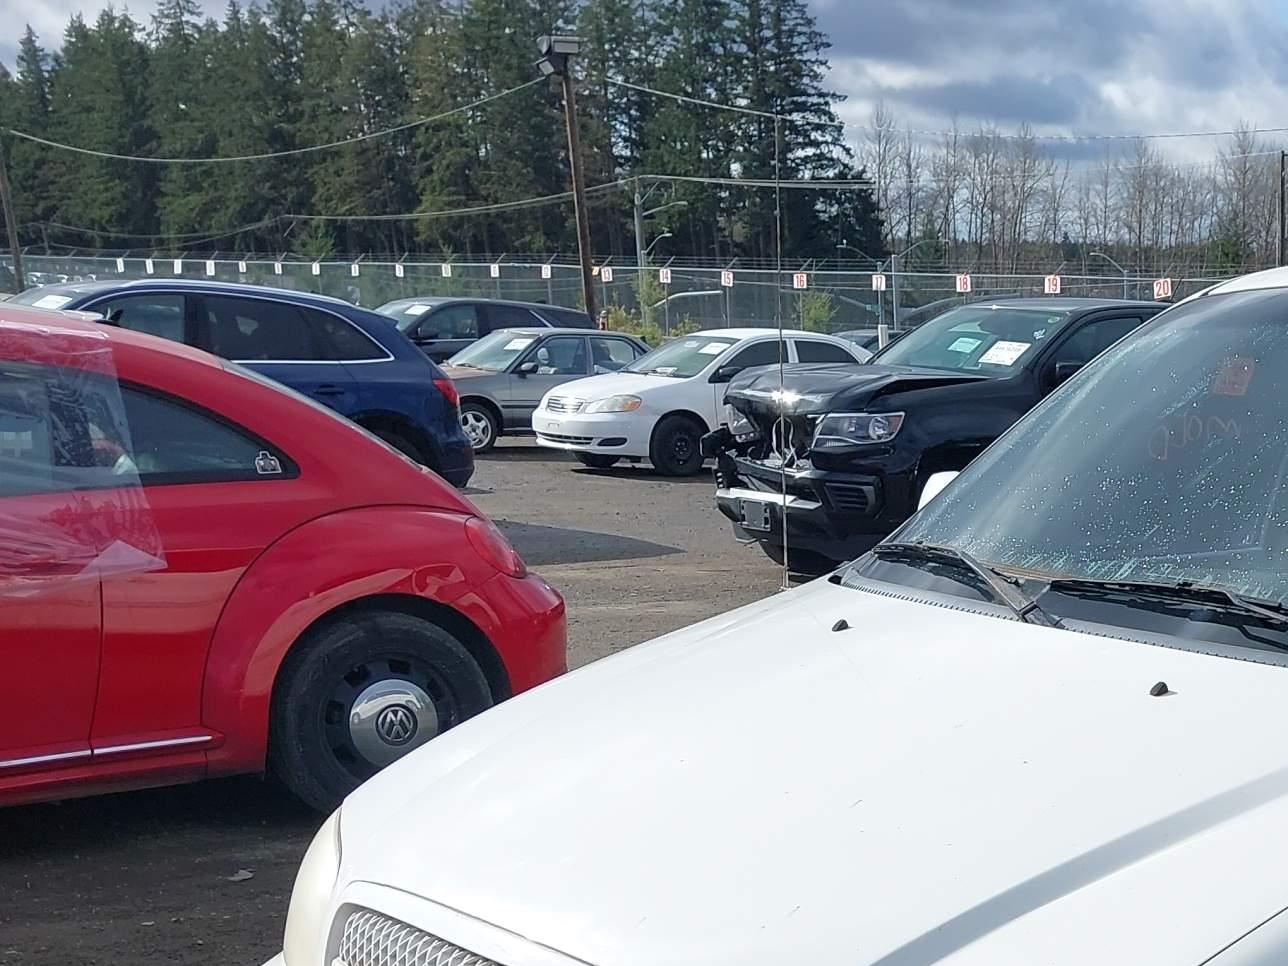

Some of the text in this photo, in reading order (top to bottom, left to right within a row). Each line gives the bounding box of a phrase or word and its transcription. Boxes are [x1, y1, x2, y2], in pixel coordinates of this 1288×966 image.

[602, 269, 611, 281] 13
[661, 270, 670, 282] 14
[723, 272, 732, 285] 15
[795, 274, 805, 288] 16
[875, 276, 883, 288] 17
[958, 276, 968, 291] 18
[1047, 276, 1058, 292] 19
[1155, 280, 1169, 297] 20
